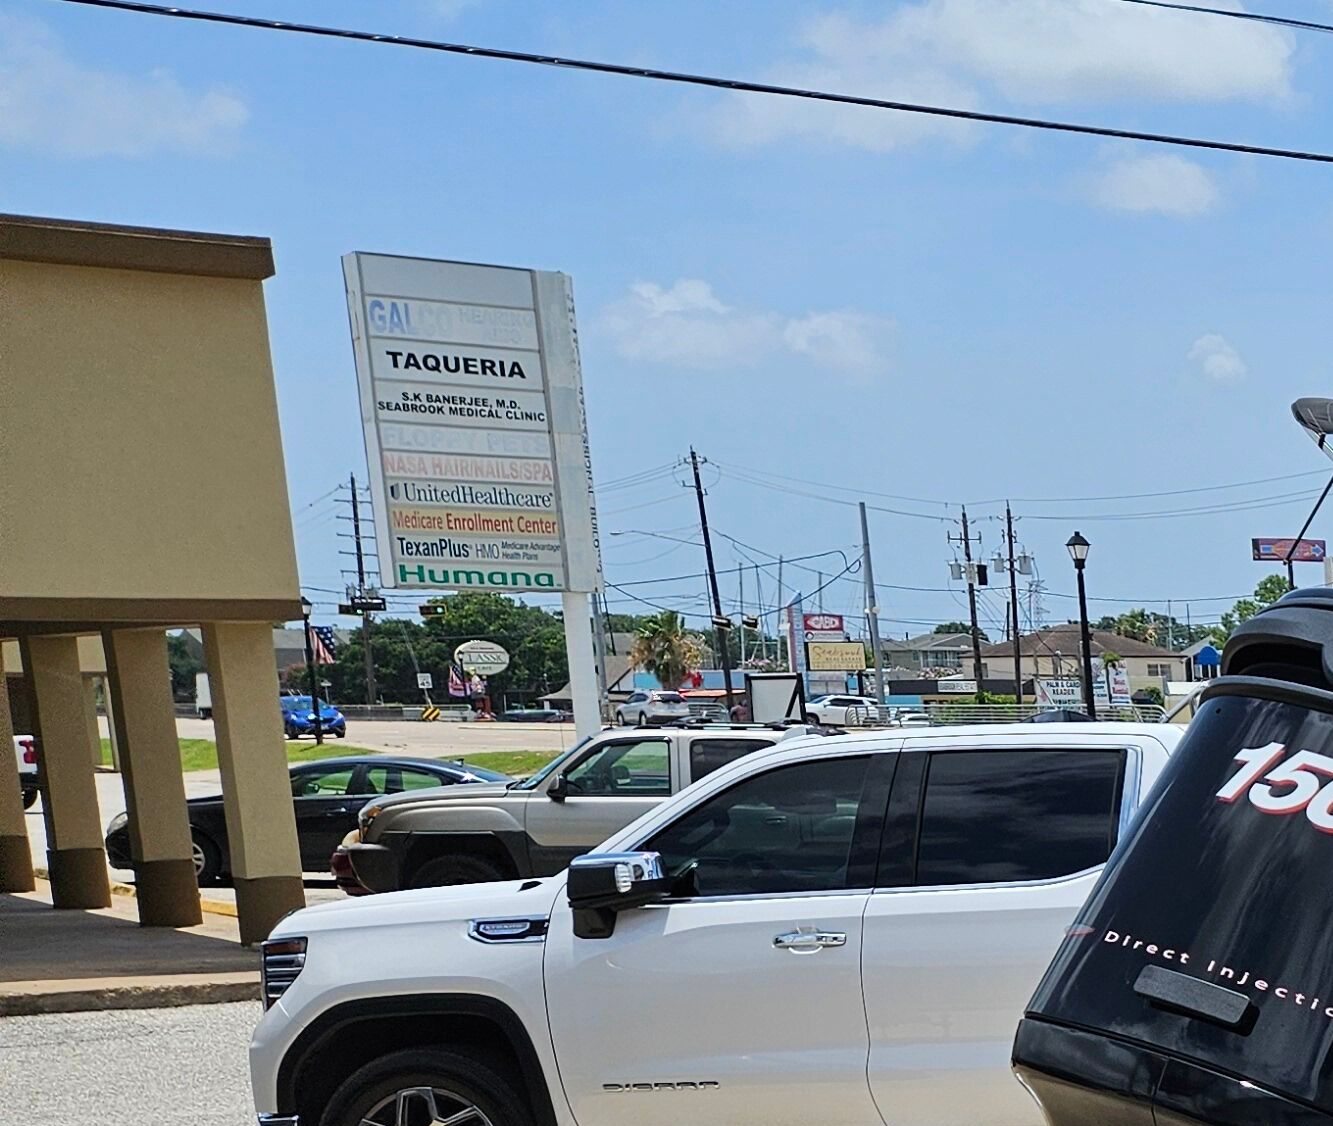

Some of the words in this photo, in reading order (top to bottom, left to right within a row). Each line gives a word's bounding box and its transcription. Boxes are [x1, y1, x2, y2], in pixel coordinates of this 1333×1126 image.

[385, 350, 527, 380] TAQUERIA
[378, 401, 446, 415] SEABROOK
[449, 407, 502, 419] MEDICAL
[505, 411, 546, 422] CLINIC
[401, 392, 421, 403] S.K
[425, 393, 492, 409] BANERJEE,
[495, 399, 521, 410] M.D.
[383, 455, 427, 475] NASA
[404, 483, 552, 508] UnitedHealthcare
[393, 510, 443, 530] Medicare
[446, 513, 514, 534] Enrollment
[518, 516, 556, 534] Center
[397, 536, 470, 558] TexanPlus
[476, 543, 500, 559] HMO
[501, 541, 528, 550] Medicare
[501, 552, 521, 560] Health
[399, 564, 555, 587] Humana
[1104, 929, 1191, 964] Direct
